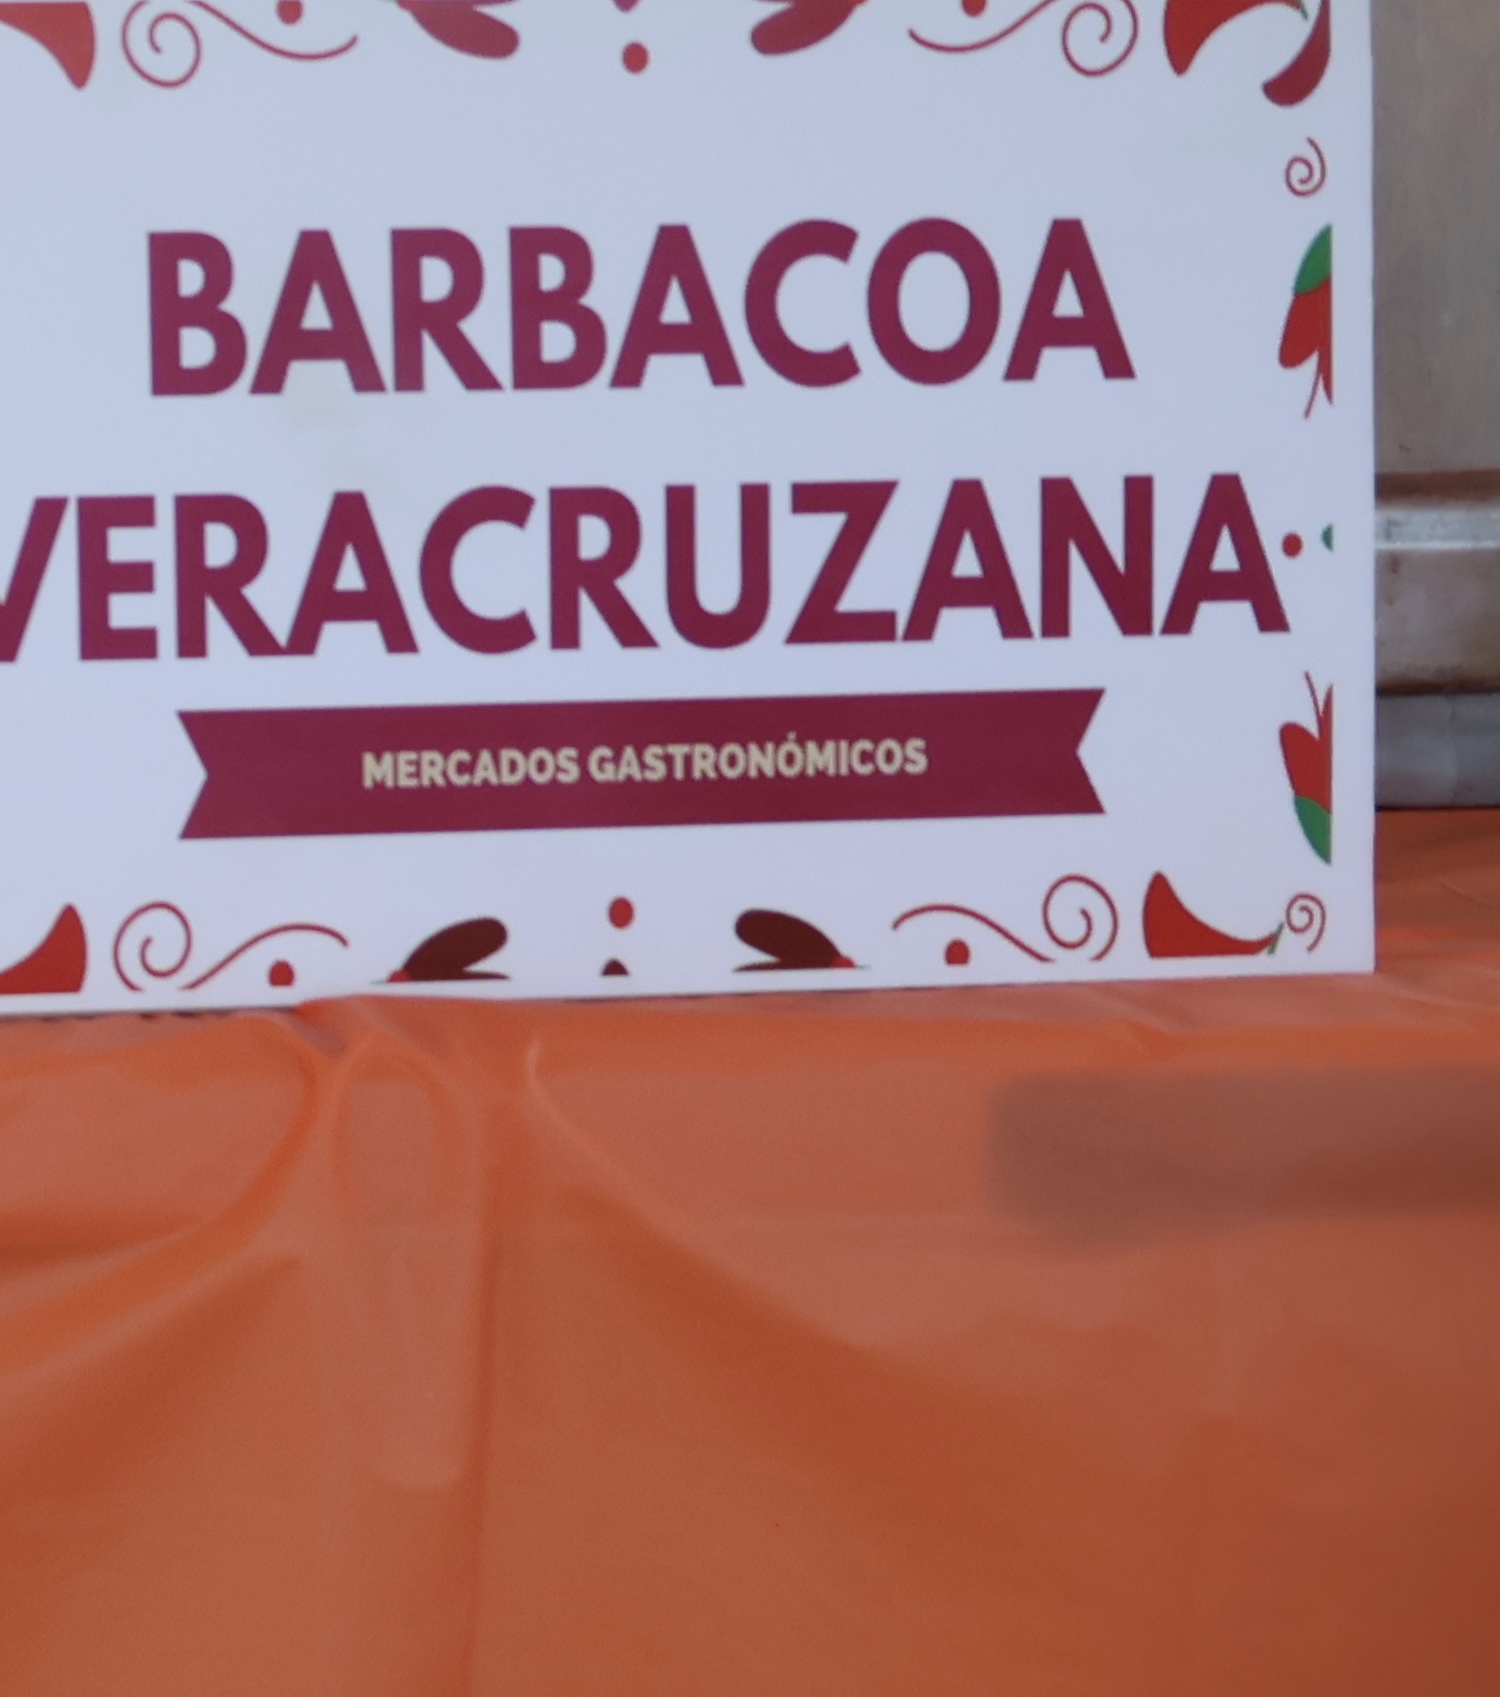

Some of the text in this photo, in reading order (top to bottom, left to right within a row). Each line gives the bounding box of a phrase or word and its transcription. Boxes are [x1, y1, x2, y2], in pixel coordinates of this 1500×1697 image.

[144, 216, 1138, 397] BARBACOA
[361, 731, 930, 790] MERCADOS GASTRONÓMICOS
